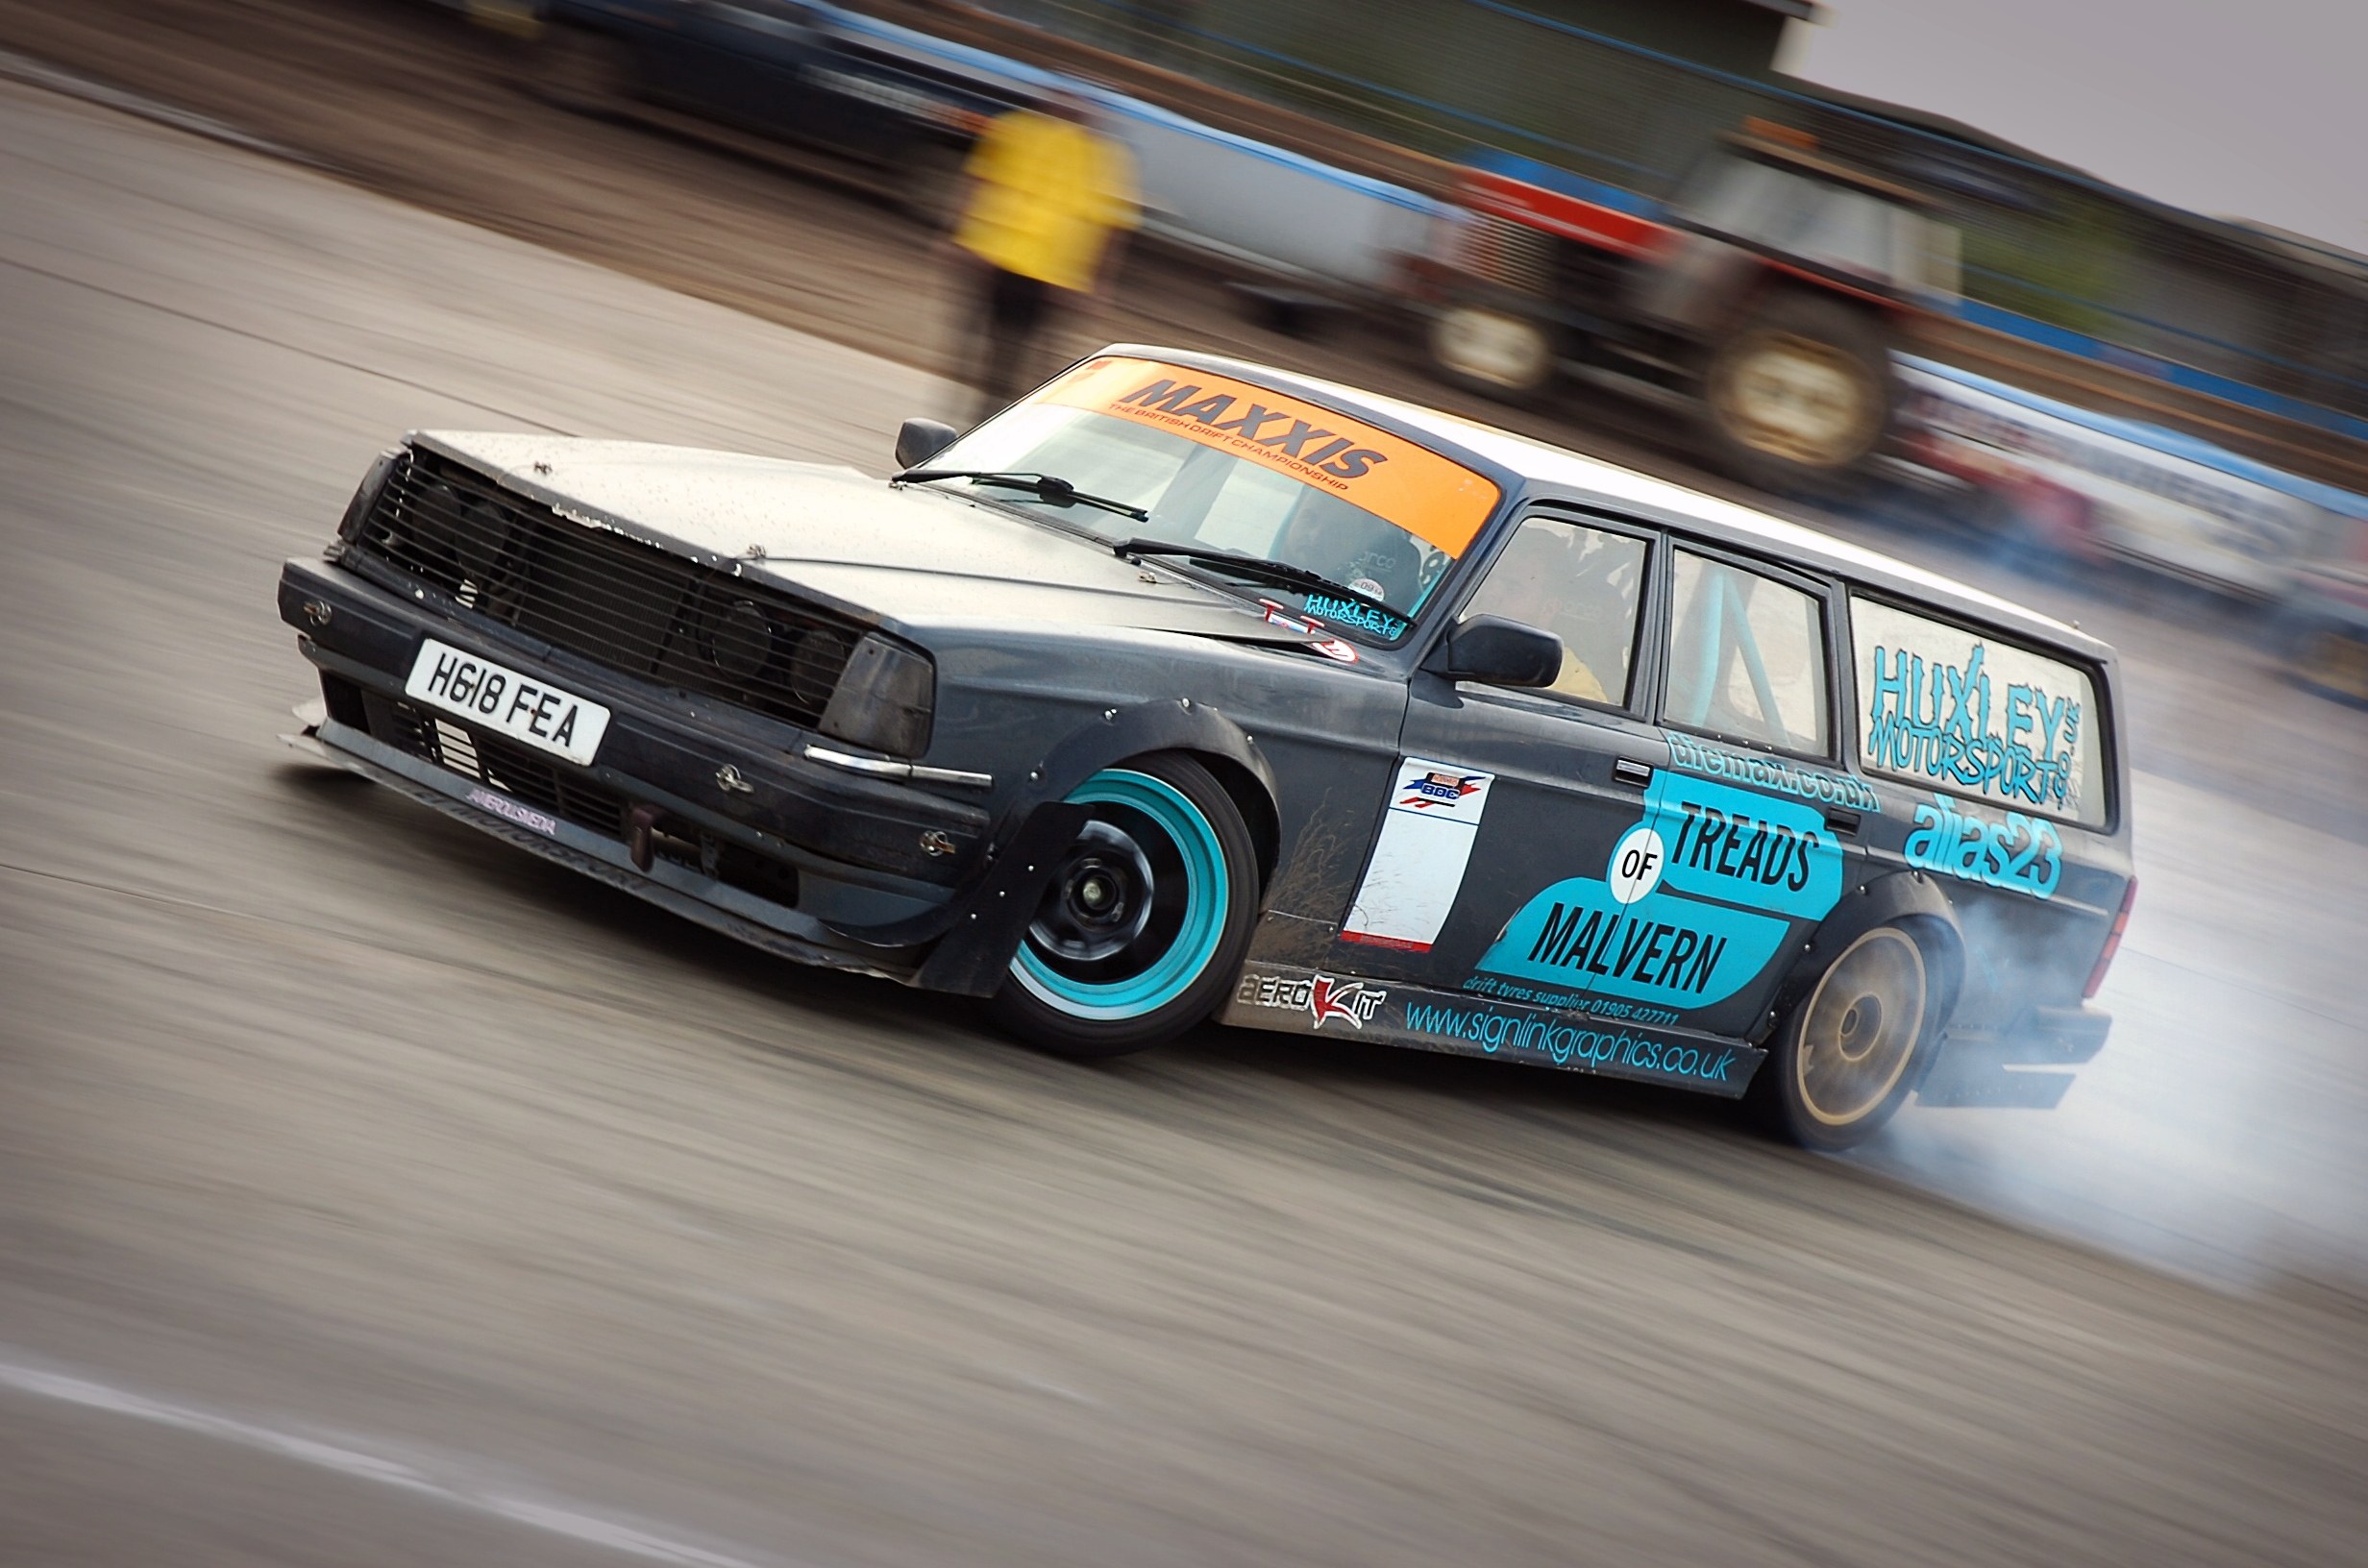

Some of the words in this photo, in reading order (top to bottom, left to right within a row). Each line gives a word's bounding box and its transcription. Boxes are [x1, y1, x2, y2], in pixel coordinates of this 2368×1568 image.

[1108, 404, 1135, 415] THE
[1135, 409, 1190, 432] BRITISH
[1188, 424, 1233, 444] DRIFT
[1231, 439, 1348, 491] CHAMPIONSHIP
[1120, 379, 1389, 478] MAXXIS
[1303, 605, 1391, 636] MOTORSPORT
[1305, 594, 1394, 627] HUXLEY
[428, 652, 506, 714] H618
[506, 683, 579, 747] FEA
[1870, 642, 2064, 764] HUXLEY
[1868, 715, 2059, 805] MOTORSPORT
[1621, 849, 1658, 882] OF
[1670, 801, 1820, 893] TREADS
[1905, 793, 2063, 899] alias23
[1527, 901, 1728, 994] MALVERN
[1405, 998, 1737, 1083] www.signlinkgraphics.co.uk
[1463, 975, 1498, 993] drift
[1497, 982, 1533, 1001] tyres
[1535, 992, 1589, 1012] supplier
[1590, 998, 1633, 1018] 01905
